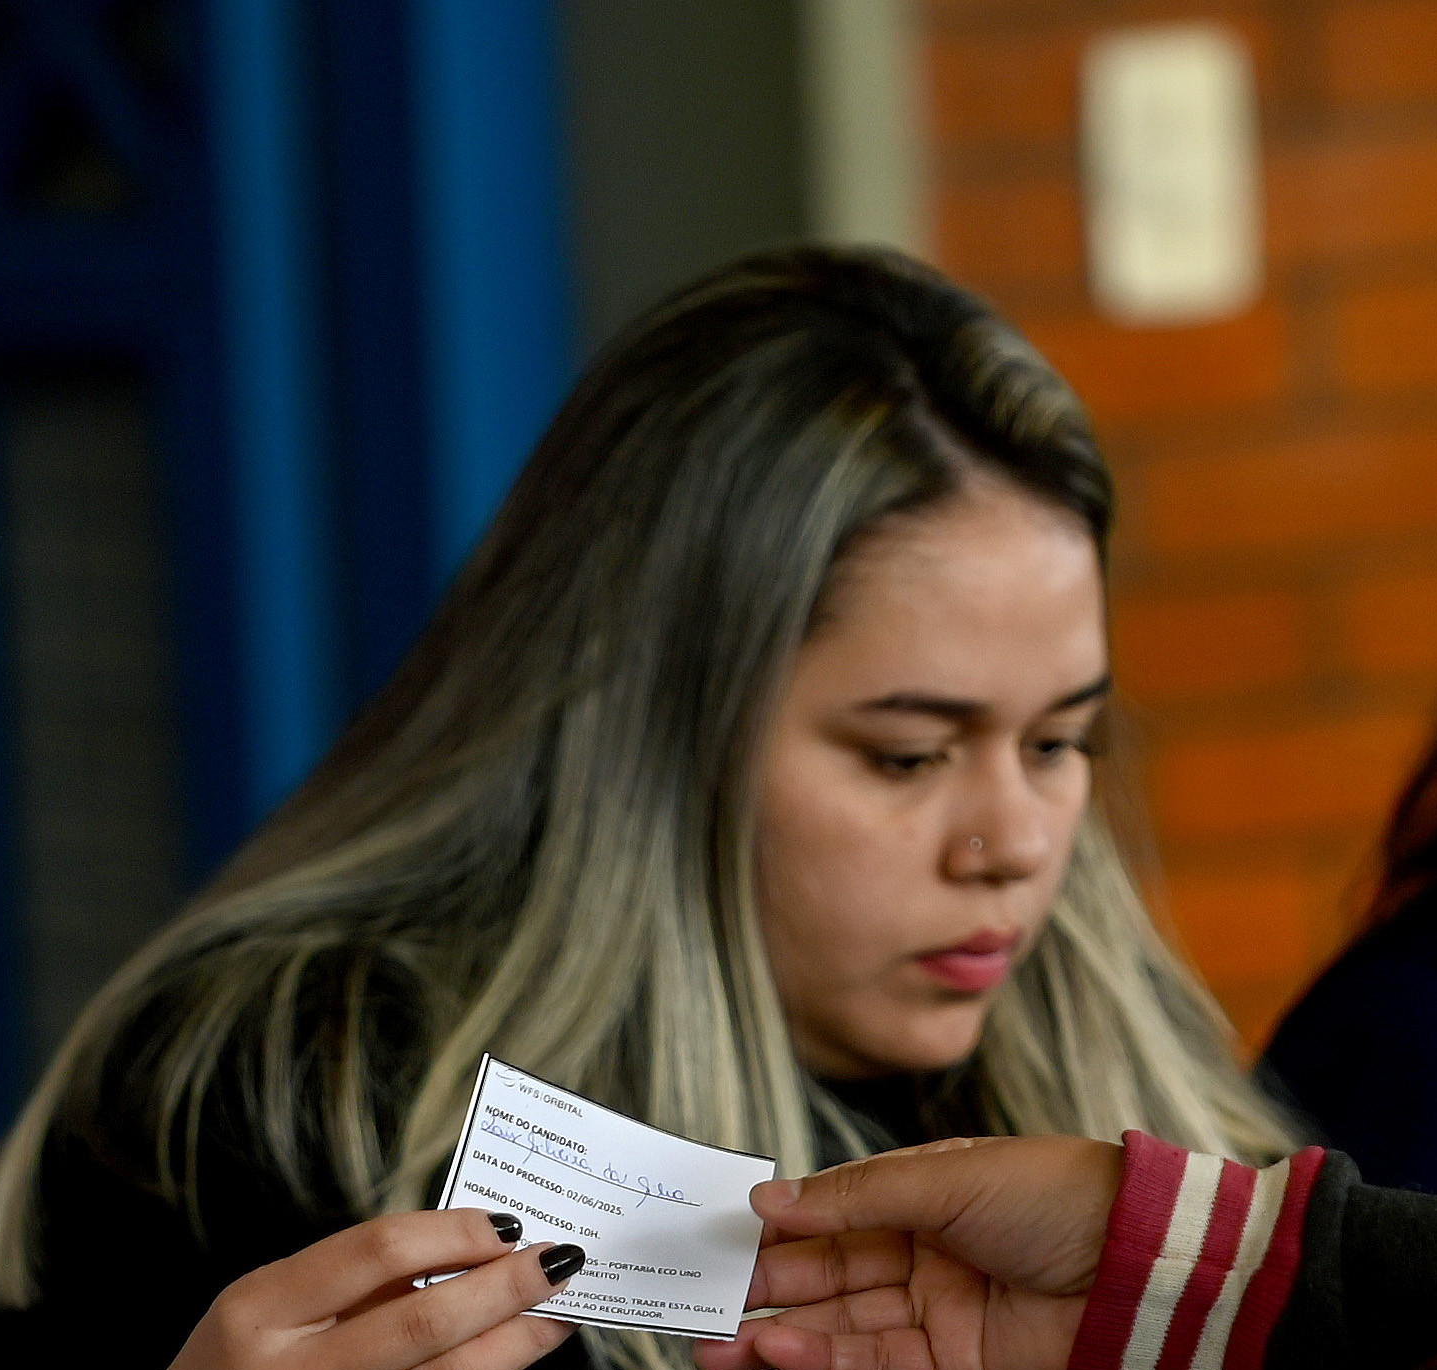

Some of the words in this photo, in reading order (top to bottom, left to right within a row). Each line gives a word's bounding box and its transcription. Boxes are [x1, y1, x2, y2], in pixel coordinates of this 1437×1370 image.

[485, 1104, 514, 1123] NOME
[516, 1117, 530, 1130] DO
[532, 1124, 588, 1155] CANDIDATO:
[473, 1150, 498, 1168] DATA
[500, 1161, 514, 1174] DO
[516, 1168, 565, 1196] PROCESSO:
[566, 1189, 625, 1217] 02/06/2025.
[464, 1180, 508, 1204] HORÁRIO
[509, 1198, 523, 1211] DO
[525, 1205, 576, 1232] PROCESSO:
[579, 1226, 601, 1240] 10H.
[609, 1261, 656, 1275] PORTARIA
[658, 1267, 677, 1276] ECO
[679, 1269, 702, 1279] UNO
[577, 1291, 629, 1305] PROCESSO,
[632, 1298, 666, 1309] TRAZER
[668, 1302, 691, 1311] ESTA
[693, 1305, 717, 1314] GUIA
[719, 1307, 725, 1315] E
[583, 1302, 597, 1311] AO
[599, 1304, 665, 1319] RECRUTADOR.
